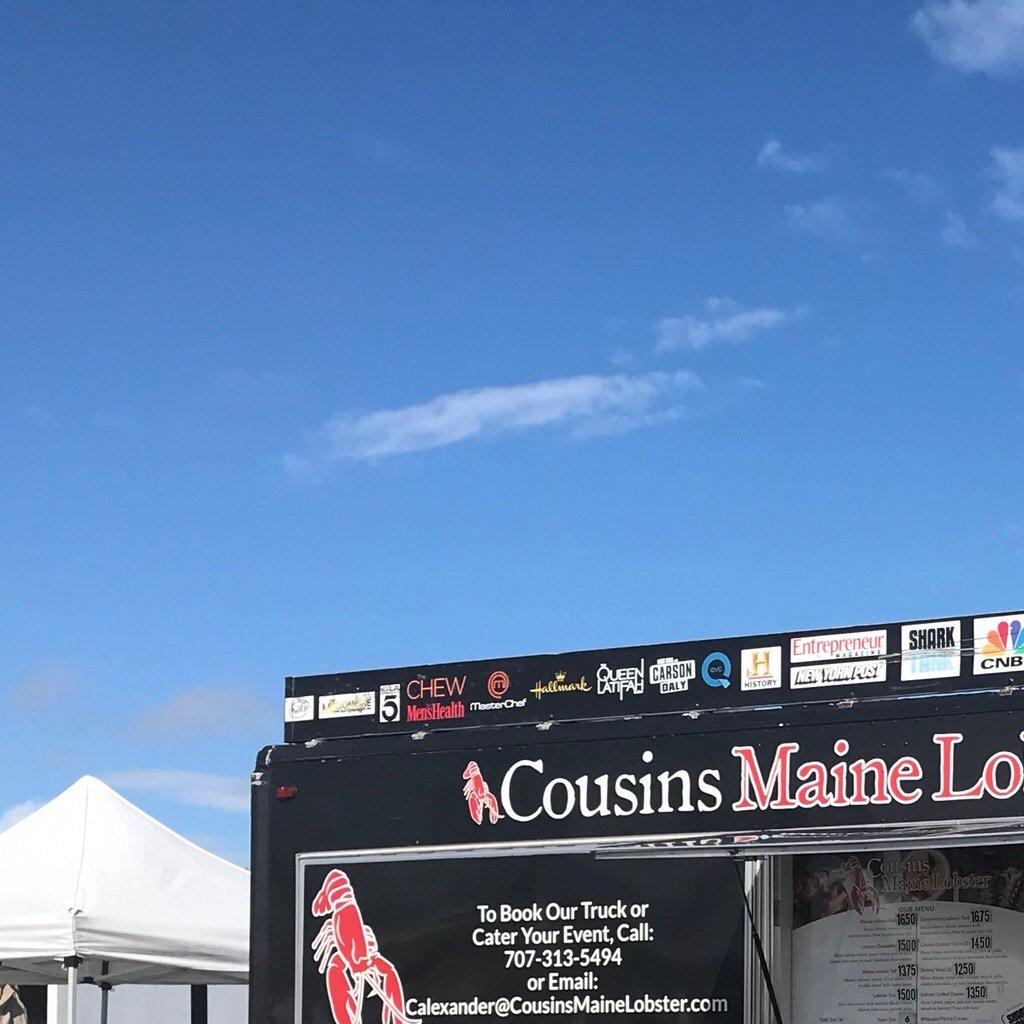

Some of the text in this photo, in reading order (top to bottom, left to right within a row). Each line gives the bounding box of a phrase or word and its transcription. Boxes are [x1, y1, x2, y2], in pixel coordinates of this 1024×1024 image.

[793, 635, 885, 656] Entrepreneur
[909, 627, 955, 650] SHARK
[597, 658, 644, 681] QUEEN
[653, 663, 692, 682] CARSON
[795, 662, 882, 685] NEW YORK POST
[406, 676, 467, 700] CHEW
[530, 677, 592, 700] Hallmark
[597, 679, 644, 701] LATIFAH
[662, 681, 687, 691] DALY
[744, 680, 777, 688] HISTORY
[382, 695, 398, 722] 5
[470, 698, 527, 711] MasterChef
[501, 750, 723, 822] Cousins
[731, 739, 923, 812] Maine
[477, 900, 649, 923] To Book Our Truck or
[897, 913, 915, 926] 1650
[971, 910, 990, 923] 1675
[472, 923, 654, 946] Cater Your Event, Call:
[971, 937, 990, 949] 1450
[898, 940, 916, 951] 1500
[504, 948, 622, 968] 707-313-5494
[898, 964, 916, 977] 1375
[954, 962, 974, 975] 1250
[527, 972, 598, 991] or Email:
[897, 988, 915, 1000] 1500
[966, 986, 986, 998] 1350
[405, 994, 728, 1017] Calexander@CousinsMaineLobster.com
[904, 1015, 910, 1023] 6
